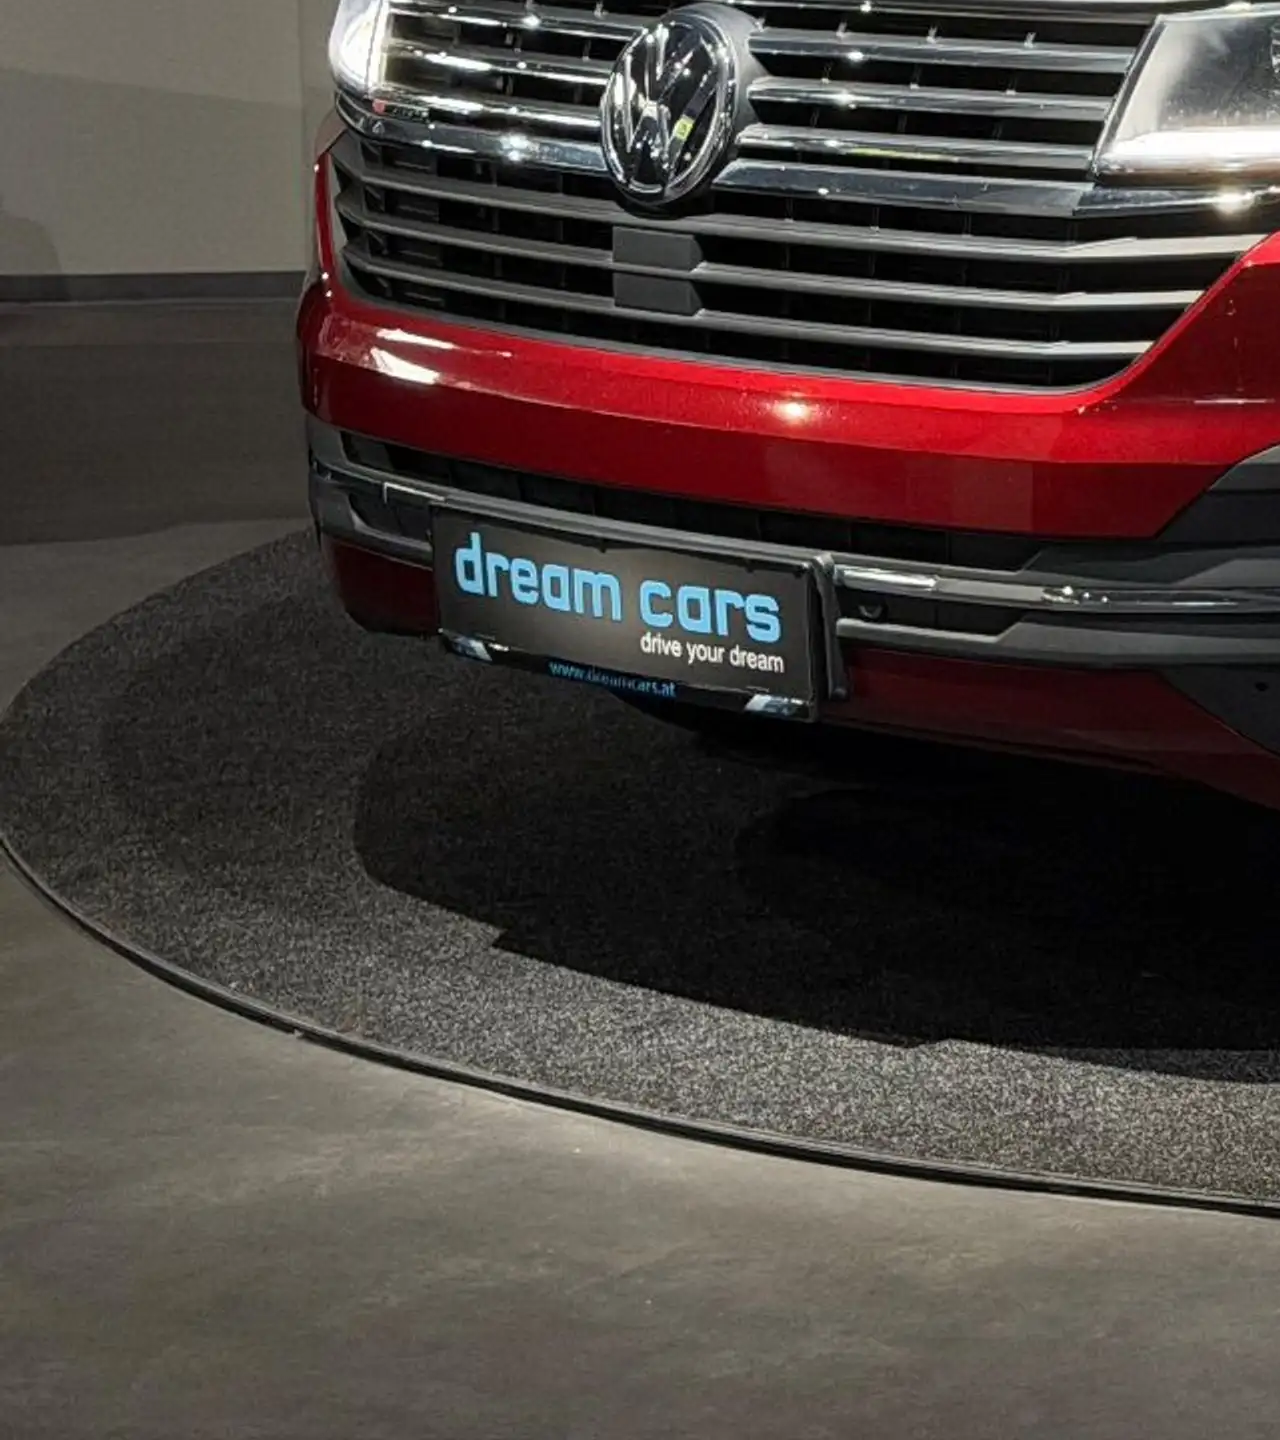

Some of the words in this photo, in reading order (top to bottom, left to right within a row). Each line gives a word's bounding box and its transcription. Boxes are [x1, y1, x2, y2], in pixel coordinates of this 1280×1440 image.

[453, 531, 622, 622] dream
[639, 579, 781, 644] cars
[640, 630, 682, 658] drive
[686, 639, 724, 673] your
[729, 646, 785, 674] dream
